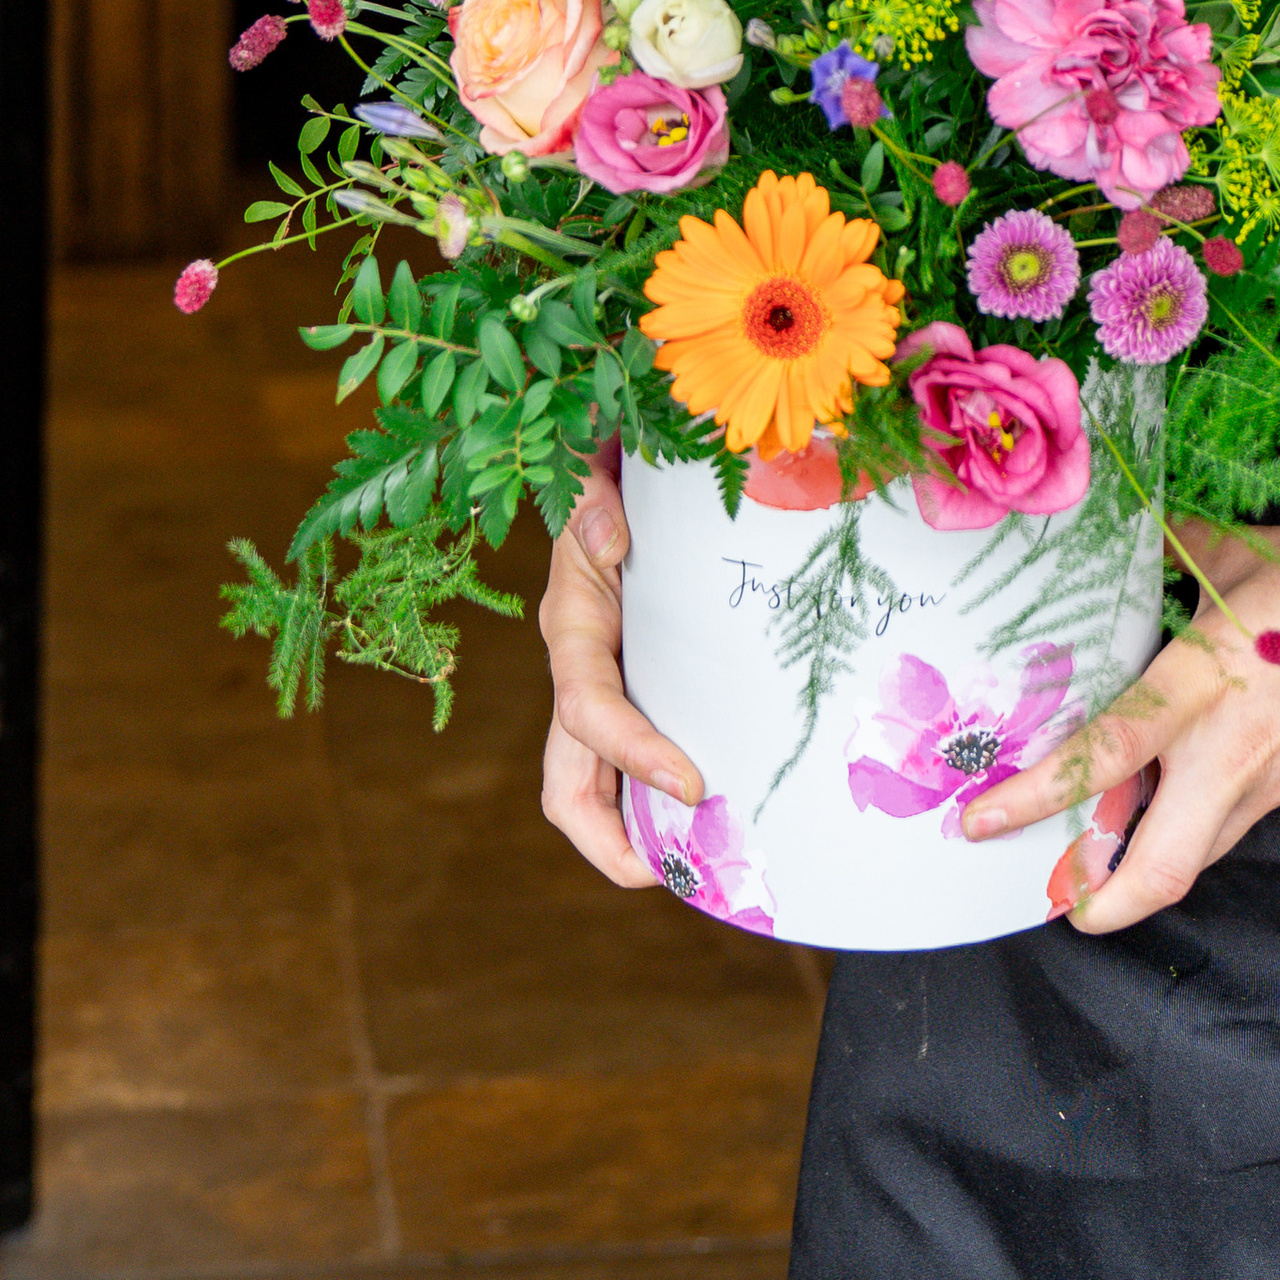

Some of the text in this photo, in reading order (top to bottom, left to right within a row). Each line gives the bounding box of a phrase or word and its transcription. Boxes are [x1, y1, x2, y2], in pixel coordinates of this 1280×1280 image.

[721, 556, 946, 637] Just for you
